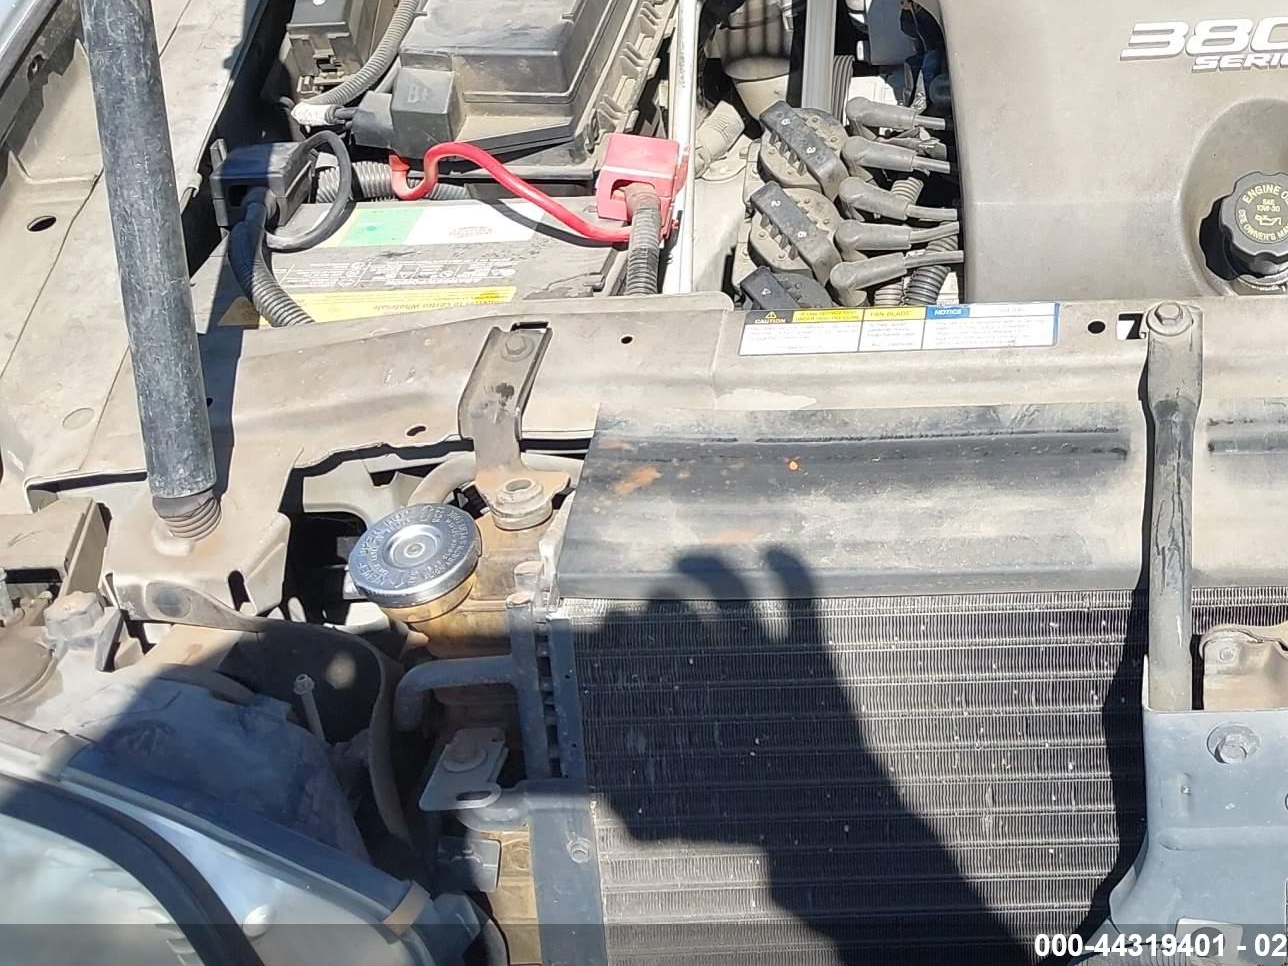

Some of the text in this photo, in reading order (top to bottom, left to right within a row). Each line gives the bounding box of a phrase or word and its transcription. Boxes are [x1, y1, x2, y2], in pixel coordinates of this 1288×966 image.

[1242, 183, 1281, 204] ENGINE
[1257, 205, 1280, 213] 10W-30
[1262, 198, 1275, 206] SAE
[1238, 209, 1248, 224] SEE
[1243, 223, 1277, 241] OWNER'S
